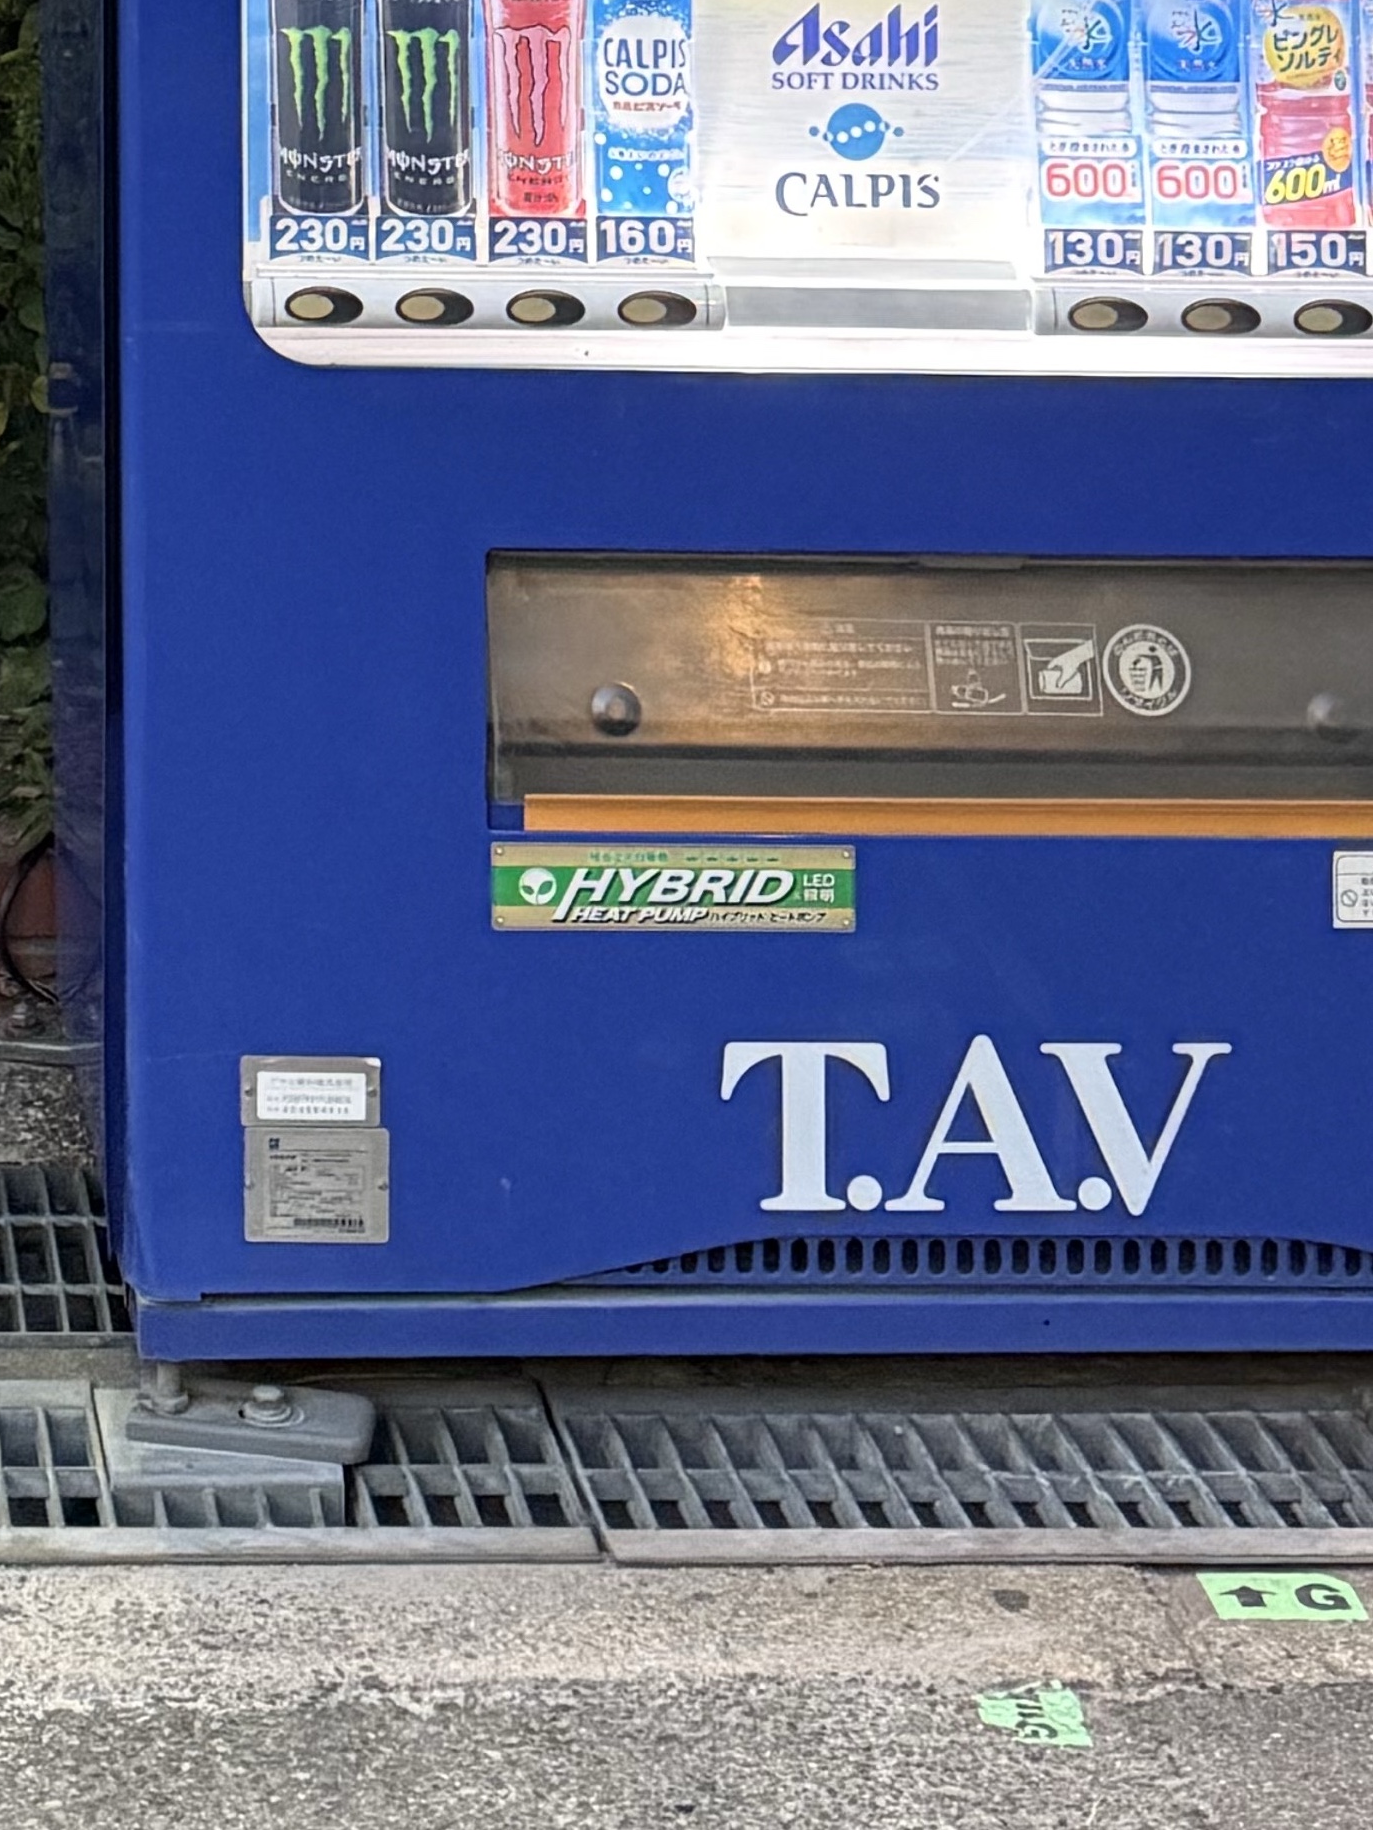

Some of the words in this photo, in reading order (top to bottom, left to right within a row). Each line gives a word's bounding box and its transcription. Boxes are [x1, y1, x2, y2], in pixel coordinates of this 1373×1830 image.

[772, 2, 938, 67] Asahi
[1273, 24, 1339, 52] ピングレ
[604, 37, 686, 69] CALPIS
[1278, 47, 1341, 72] ソルティ
[605, 70, 687, 96] SODA
[772, 72, 834, 90] SOFT
[842, 72, 939, 91] DRINKS
[775, 171, 941, 217] CALPIS
[1046, 163, 1126, 198] 600
[1157, 164, 1237, 199] 600
[551, 867, 795, 922] HYBRID
[802, 873, 835, 888] LED
[803, 887, 835, 903] 照明
[572, 907, 637, 923] HEAT
[638, 907, 708, 924] PUMP
[1293, 1582, 1353, 1611] G
